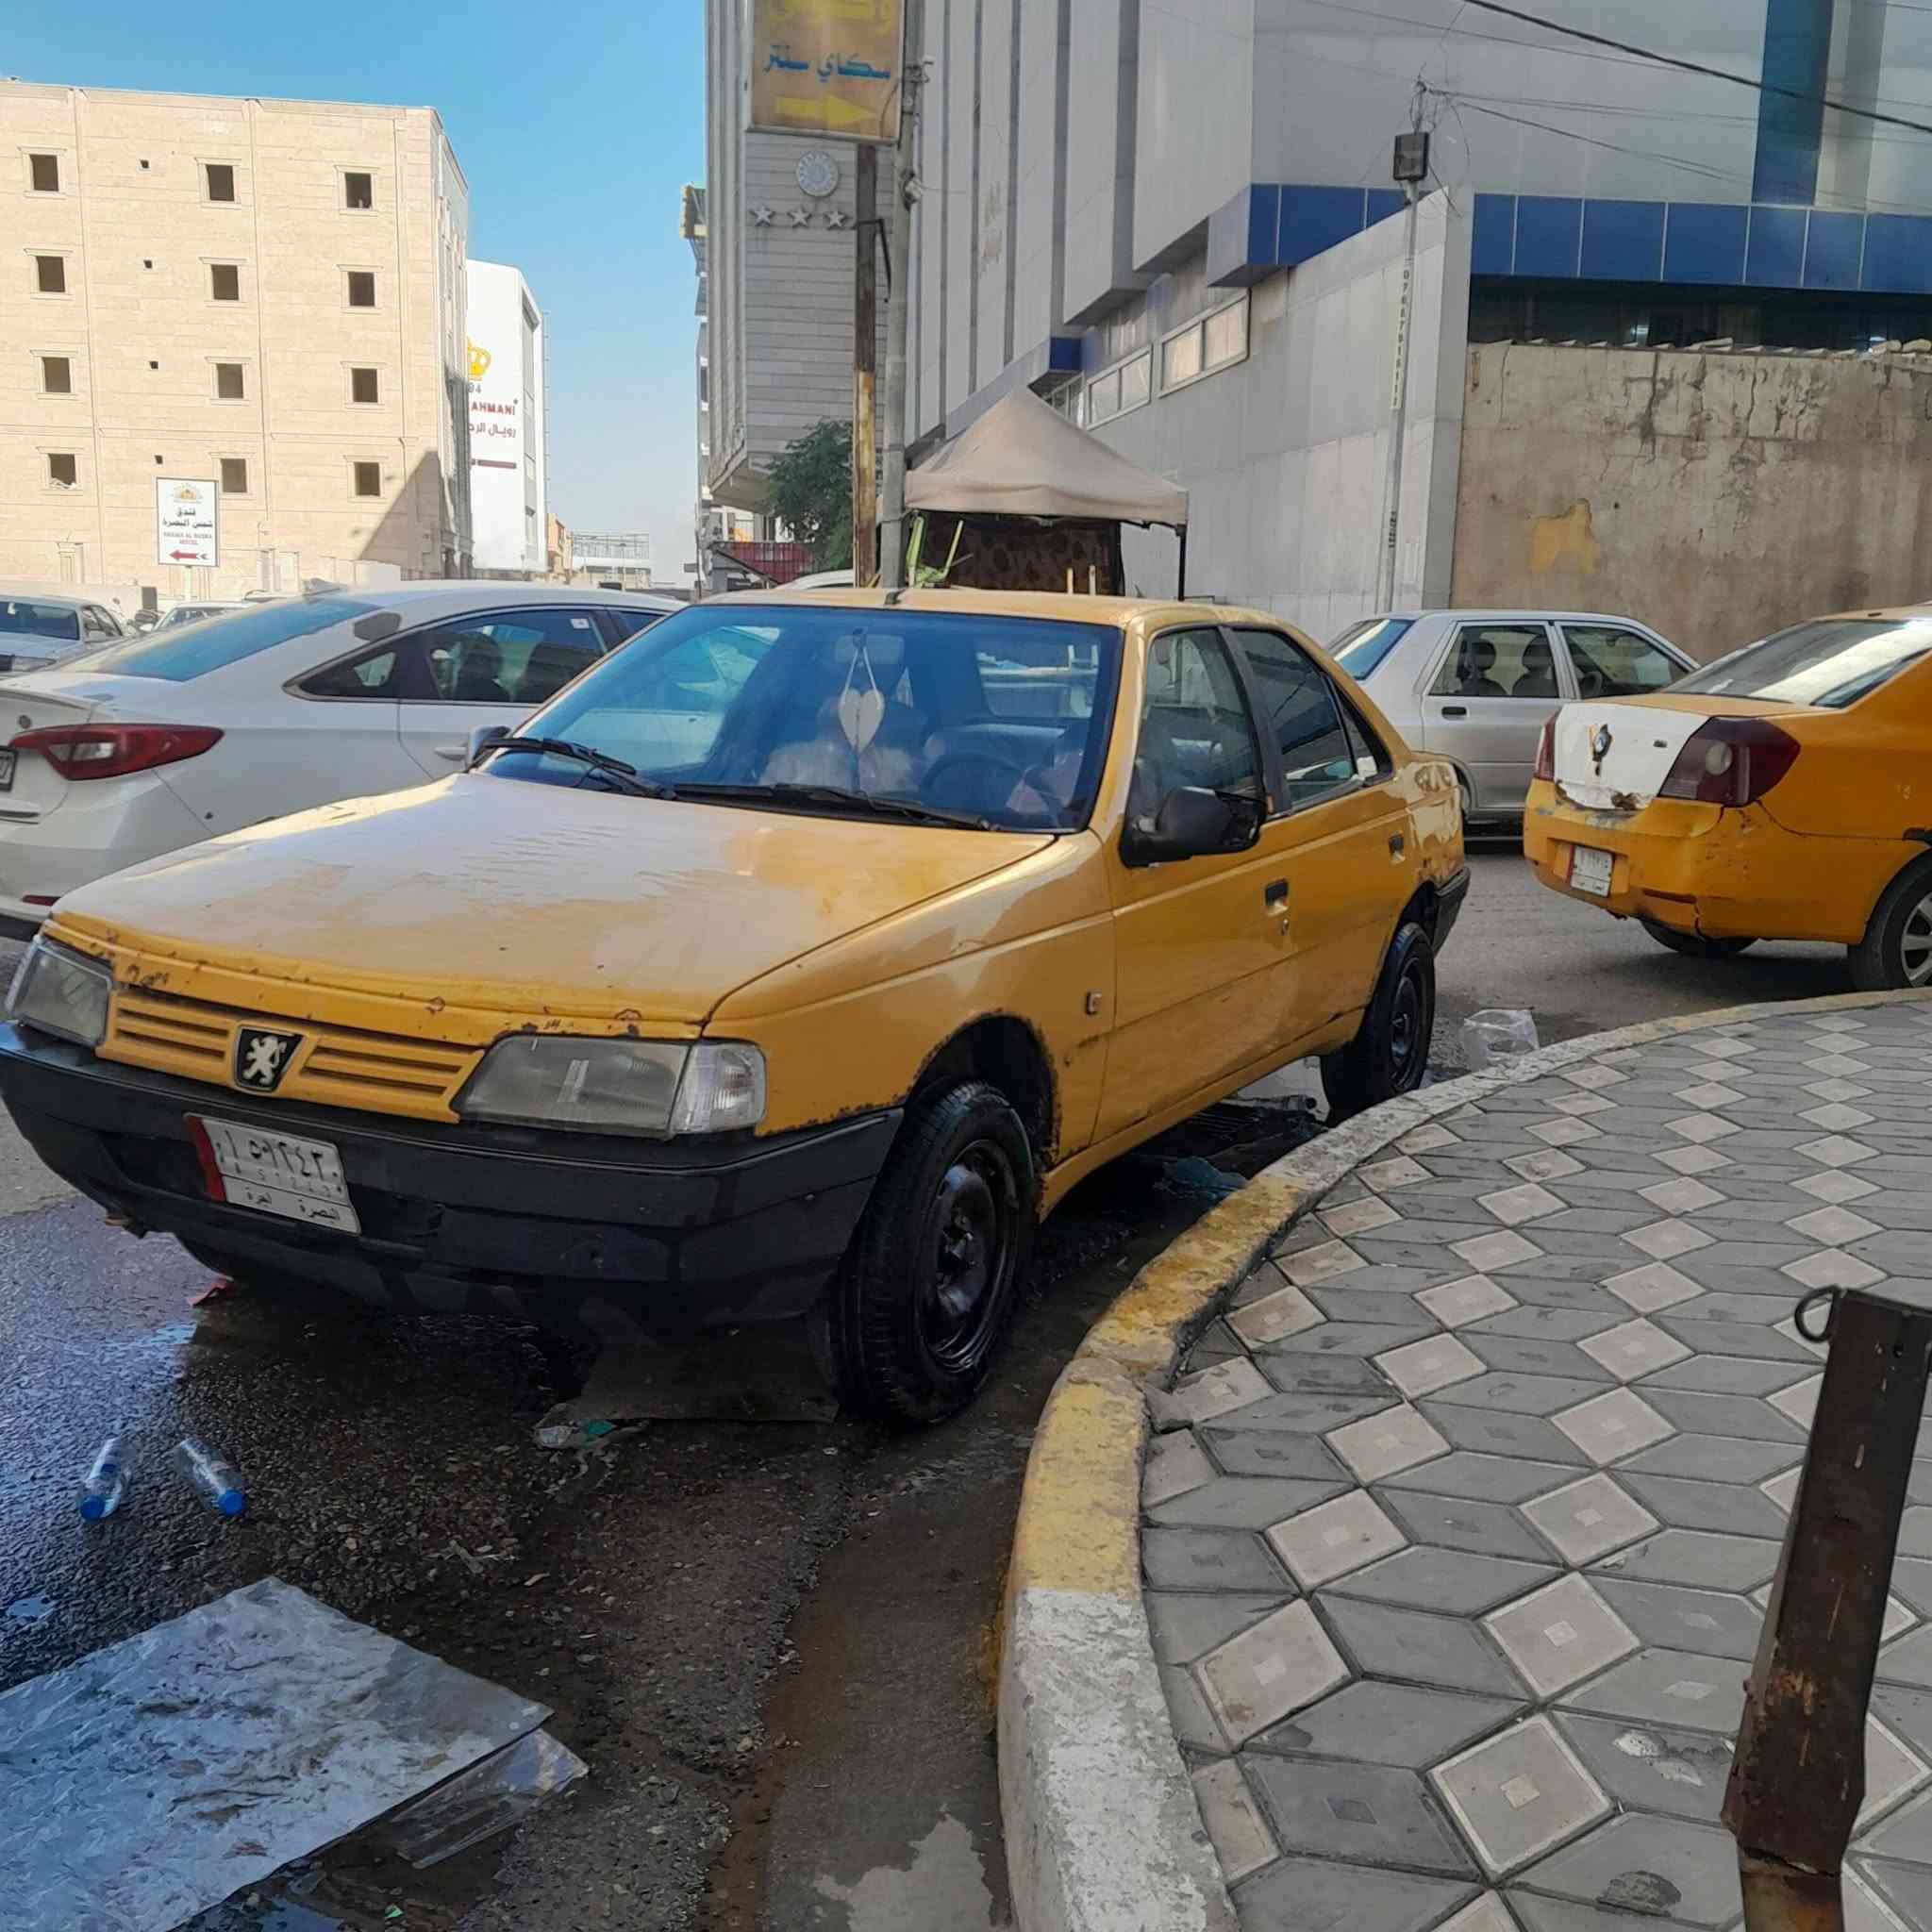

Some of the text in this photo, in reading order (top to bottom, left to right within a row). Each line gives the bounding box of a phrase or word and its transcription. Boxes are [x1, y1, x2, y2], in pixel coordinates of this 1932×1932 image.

[817, 52, 891, 83] سكاي
[469, 400, 516, 416] AHMANI
[468, 422, 487, 435] الرح
